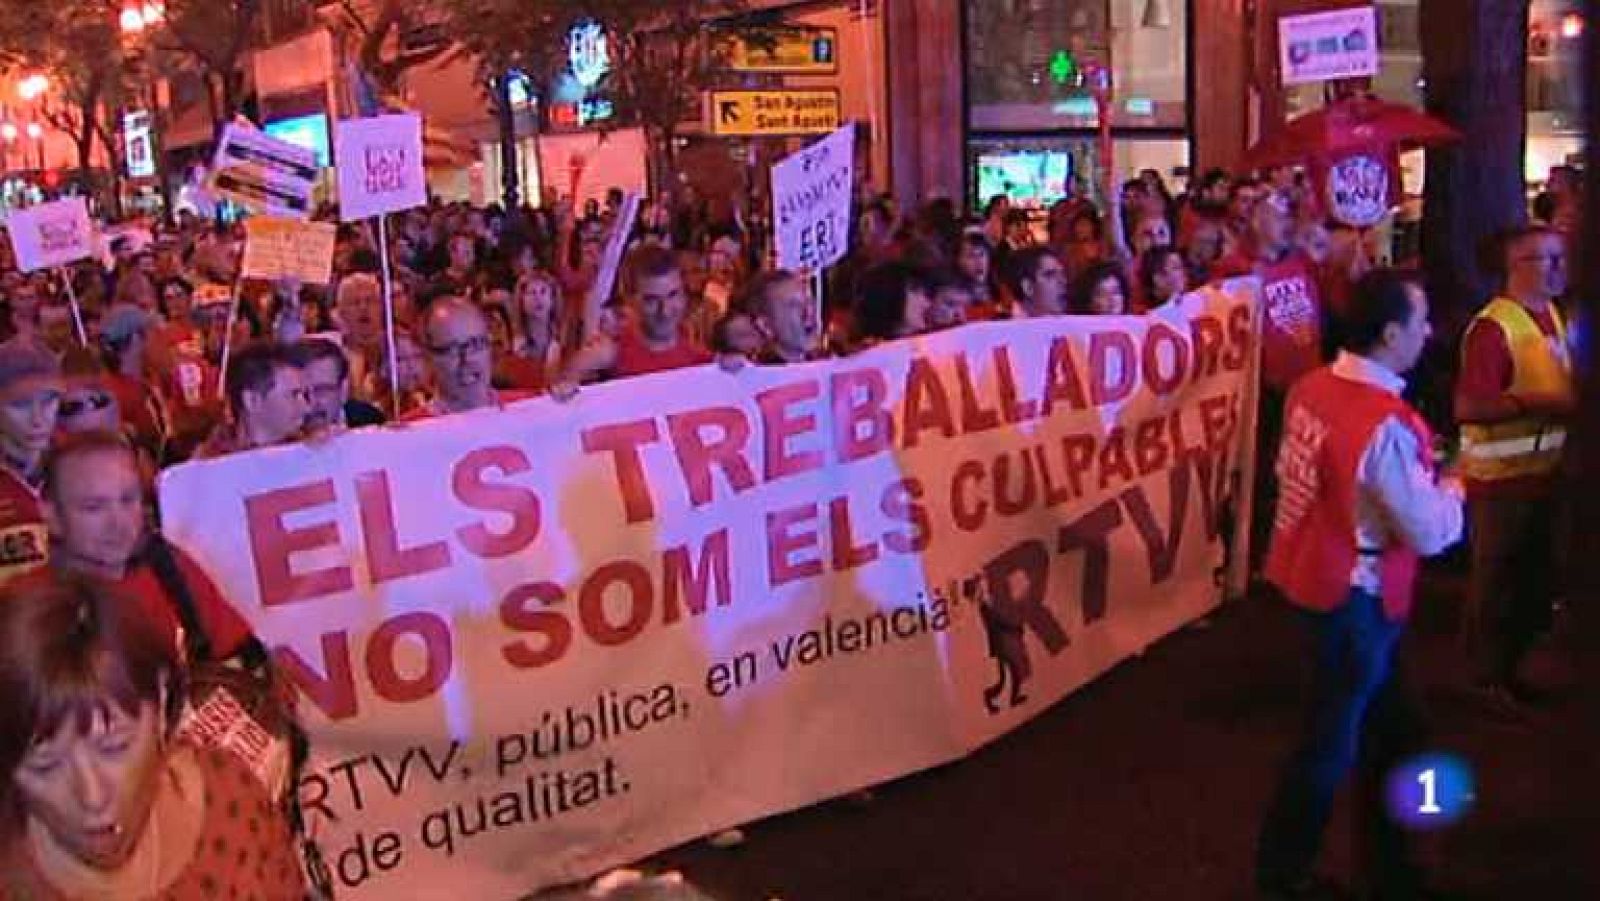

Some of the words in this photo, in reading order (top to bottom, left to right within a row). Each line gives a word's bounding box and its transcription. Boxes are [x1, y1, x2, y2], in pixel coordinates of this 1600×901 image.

[244, 445, 542, 607] ELS
[581, 304, 1249, 525] TREBALLADORS
[272, 611, 453, 722] NO
[500, 527, 732, 669] SOM
[766, 477, 931, 587] ELS
[498, 683, 690, 777] pública,
[705, 651, 757, 698] en
[338, 833, 402, 887] de
[420, 757, 632, 857] qualitat.
